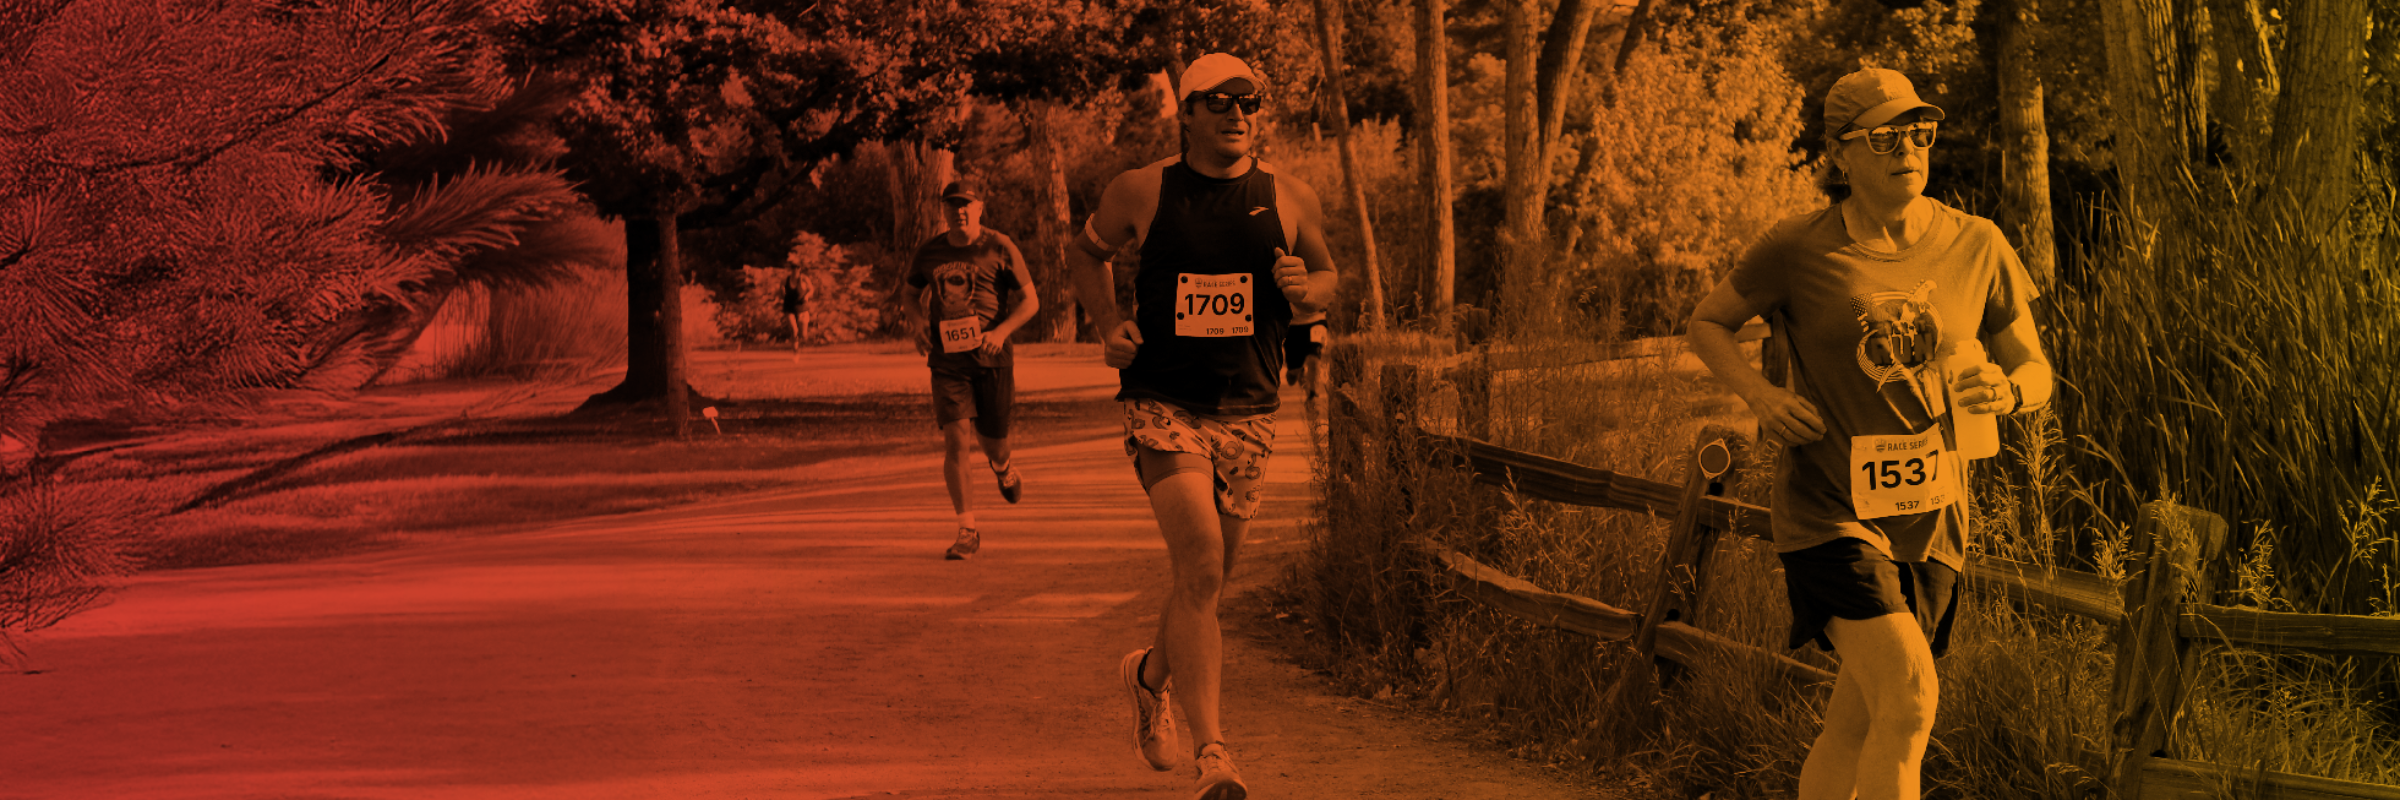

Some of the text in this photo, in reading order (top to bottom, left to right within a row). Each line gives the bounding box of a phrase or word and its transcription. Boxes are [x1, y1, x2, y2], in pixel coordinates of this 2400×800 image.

[1185, 293, 1244, 316] 1709
[945, 326, 976, 342] 1651
[1206, 327, 1225, 335] 1709
[1867, 332, 1934, 365] RUN
[1887, 442, 1908, 452] RACE
[1862, 449, 1939, 490] 1537
[1895, 500, 1919, 511] 1537
